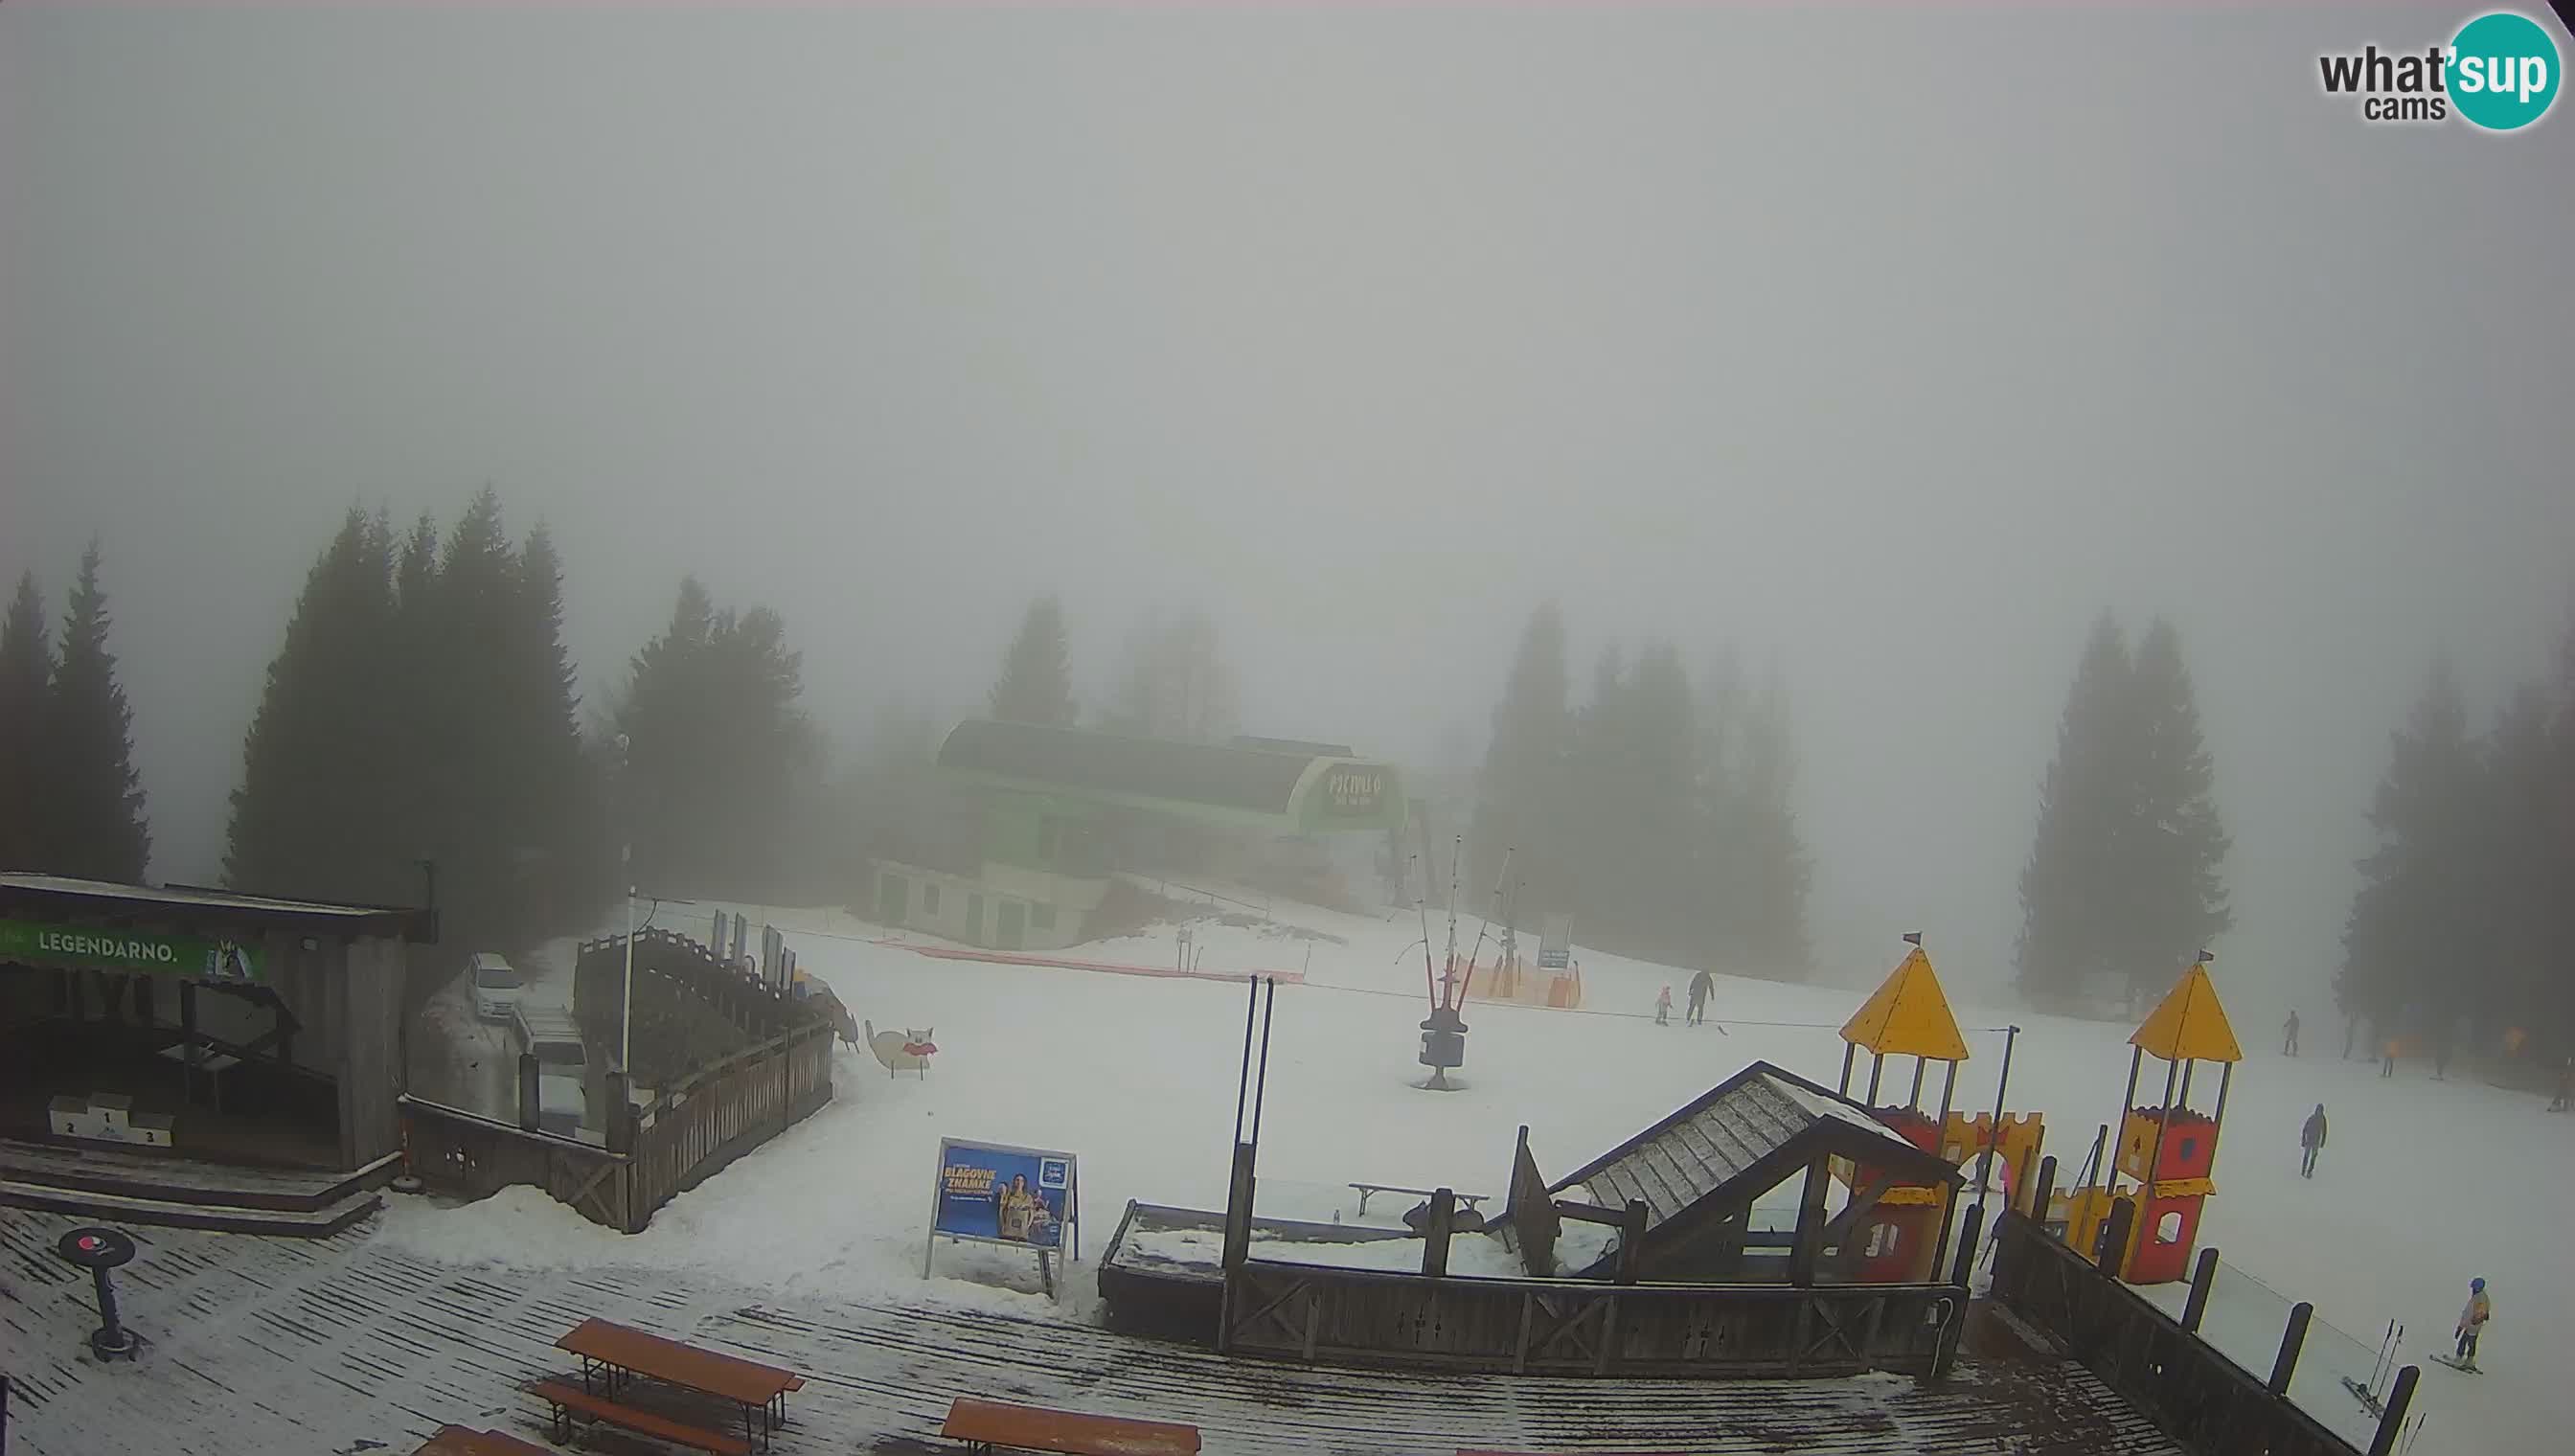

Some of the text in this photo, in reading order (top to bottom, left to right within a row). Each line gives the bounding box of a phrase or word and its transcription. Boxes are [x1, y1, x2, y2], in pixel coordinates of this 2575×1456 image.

[39, 931, 178, 962] LEGENDARNO.
[104, 1112, 110, 1123] 1
[66, 1123, 74, 1132] 2
[146, 1131, 153, 1142] 3
